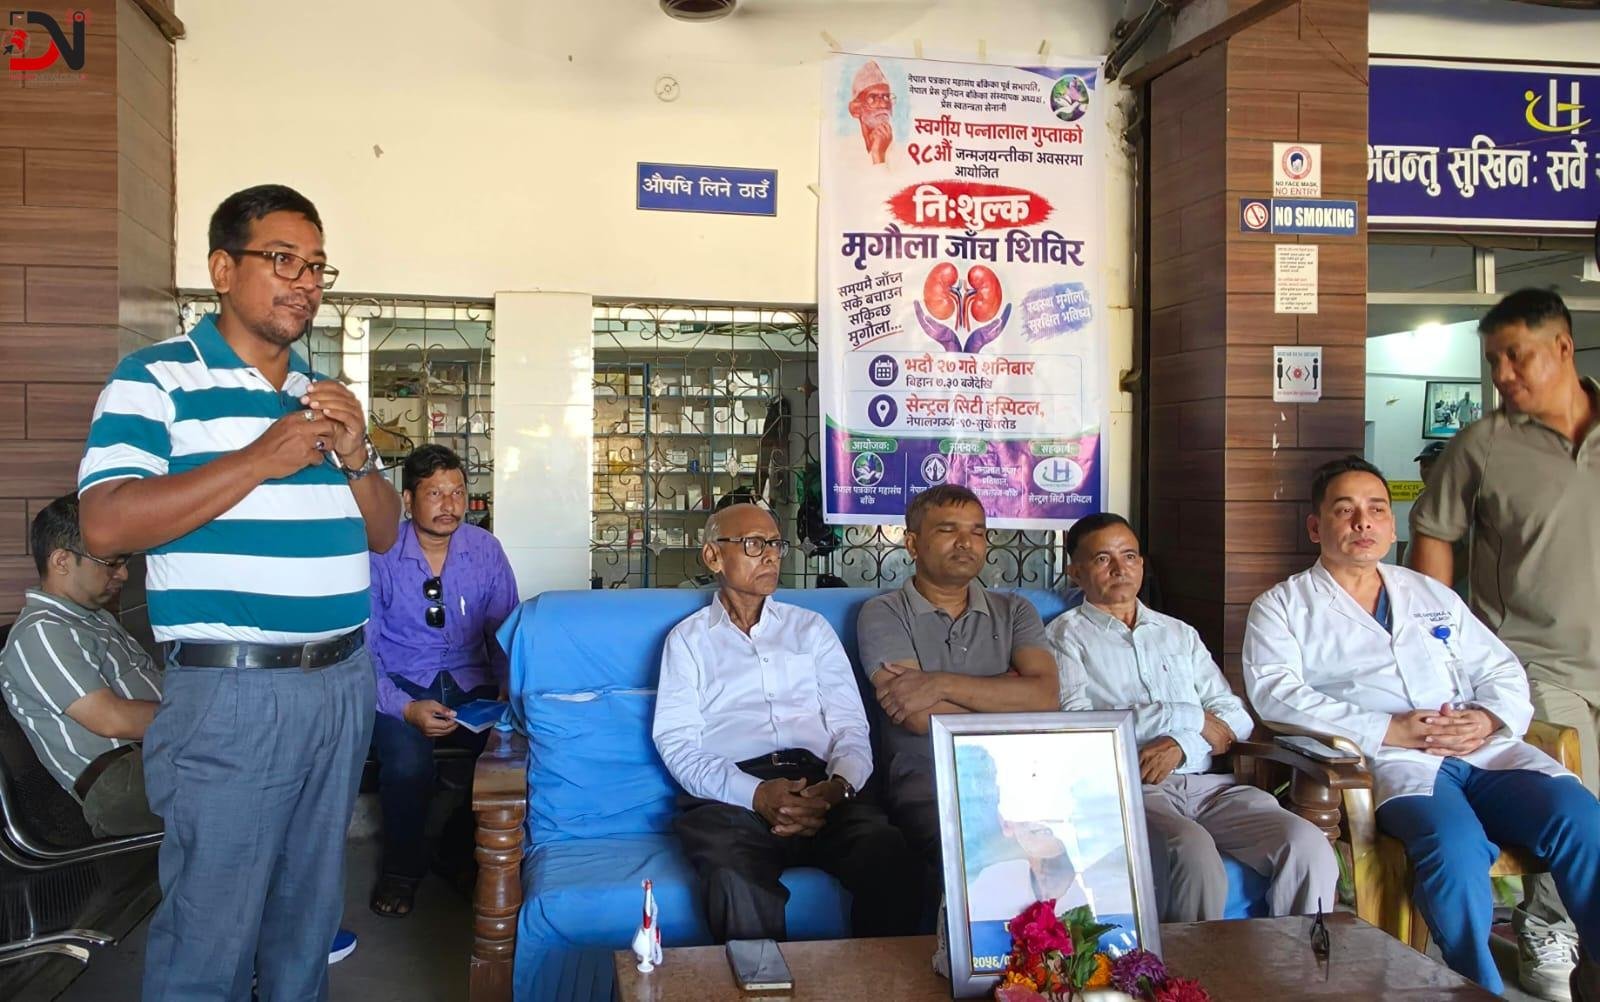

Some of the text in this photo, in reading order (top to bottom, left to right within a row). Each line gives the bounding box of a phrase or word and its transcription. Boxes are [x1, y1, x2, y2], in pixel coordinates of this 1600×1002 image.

[908, 73, 926, 83] नेपाल
[928, 76, 951, 86] पत्रकार
[909, 85, 927, 95] नेपाल
[929, 86, 940, 96] प्रेस
[941, 99, 952, 109] प्रेस
[984, 102, 1007, 112] सेनानी
[914, 114, 1083, 147] स्वर्गीय पन्नालाल गुप्ताको
[955, 146, 1033, 163] जन्मजयन्तीका
[1036, 152, 1083, 166] अवसरमा
[1546, 139, 1588, 192] सर्वे
[954, 164, 999, 179] आयोजित
[642, 172, 770, 199] औषधि लिने ठाउँ
[1275, 187, 1288, 195] NO
[1275, 206, 1355, 228] NO SMOKING
[841, 223, 1085, 270] मृगौला जाँच शिविर
[837, 275, 872, 297] समयमै
[841, 287, 902, 312] सके बचाउन
[848, 304, 892, 325] सकिन्छ
[905, 353, 1034, 375] भदौ २७ गते शनिबार
[906, 376, 933, 387] बिहान
[906, 393, 949, 416] सेन्ट्रल
[954, 394, 983, 414] सिटी
[852, 439, 890, 450] आयोजक:
[833, 484, 851, 494] नेपाल
